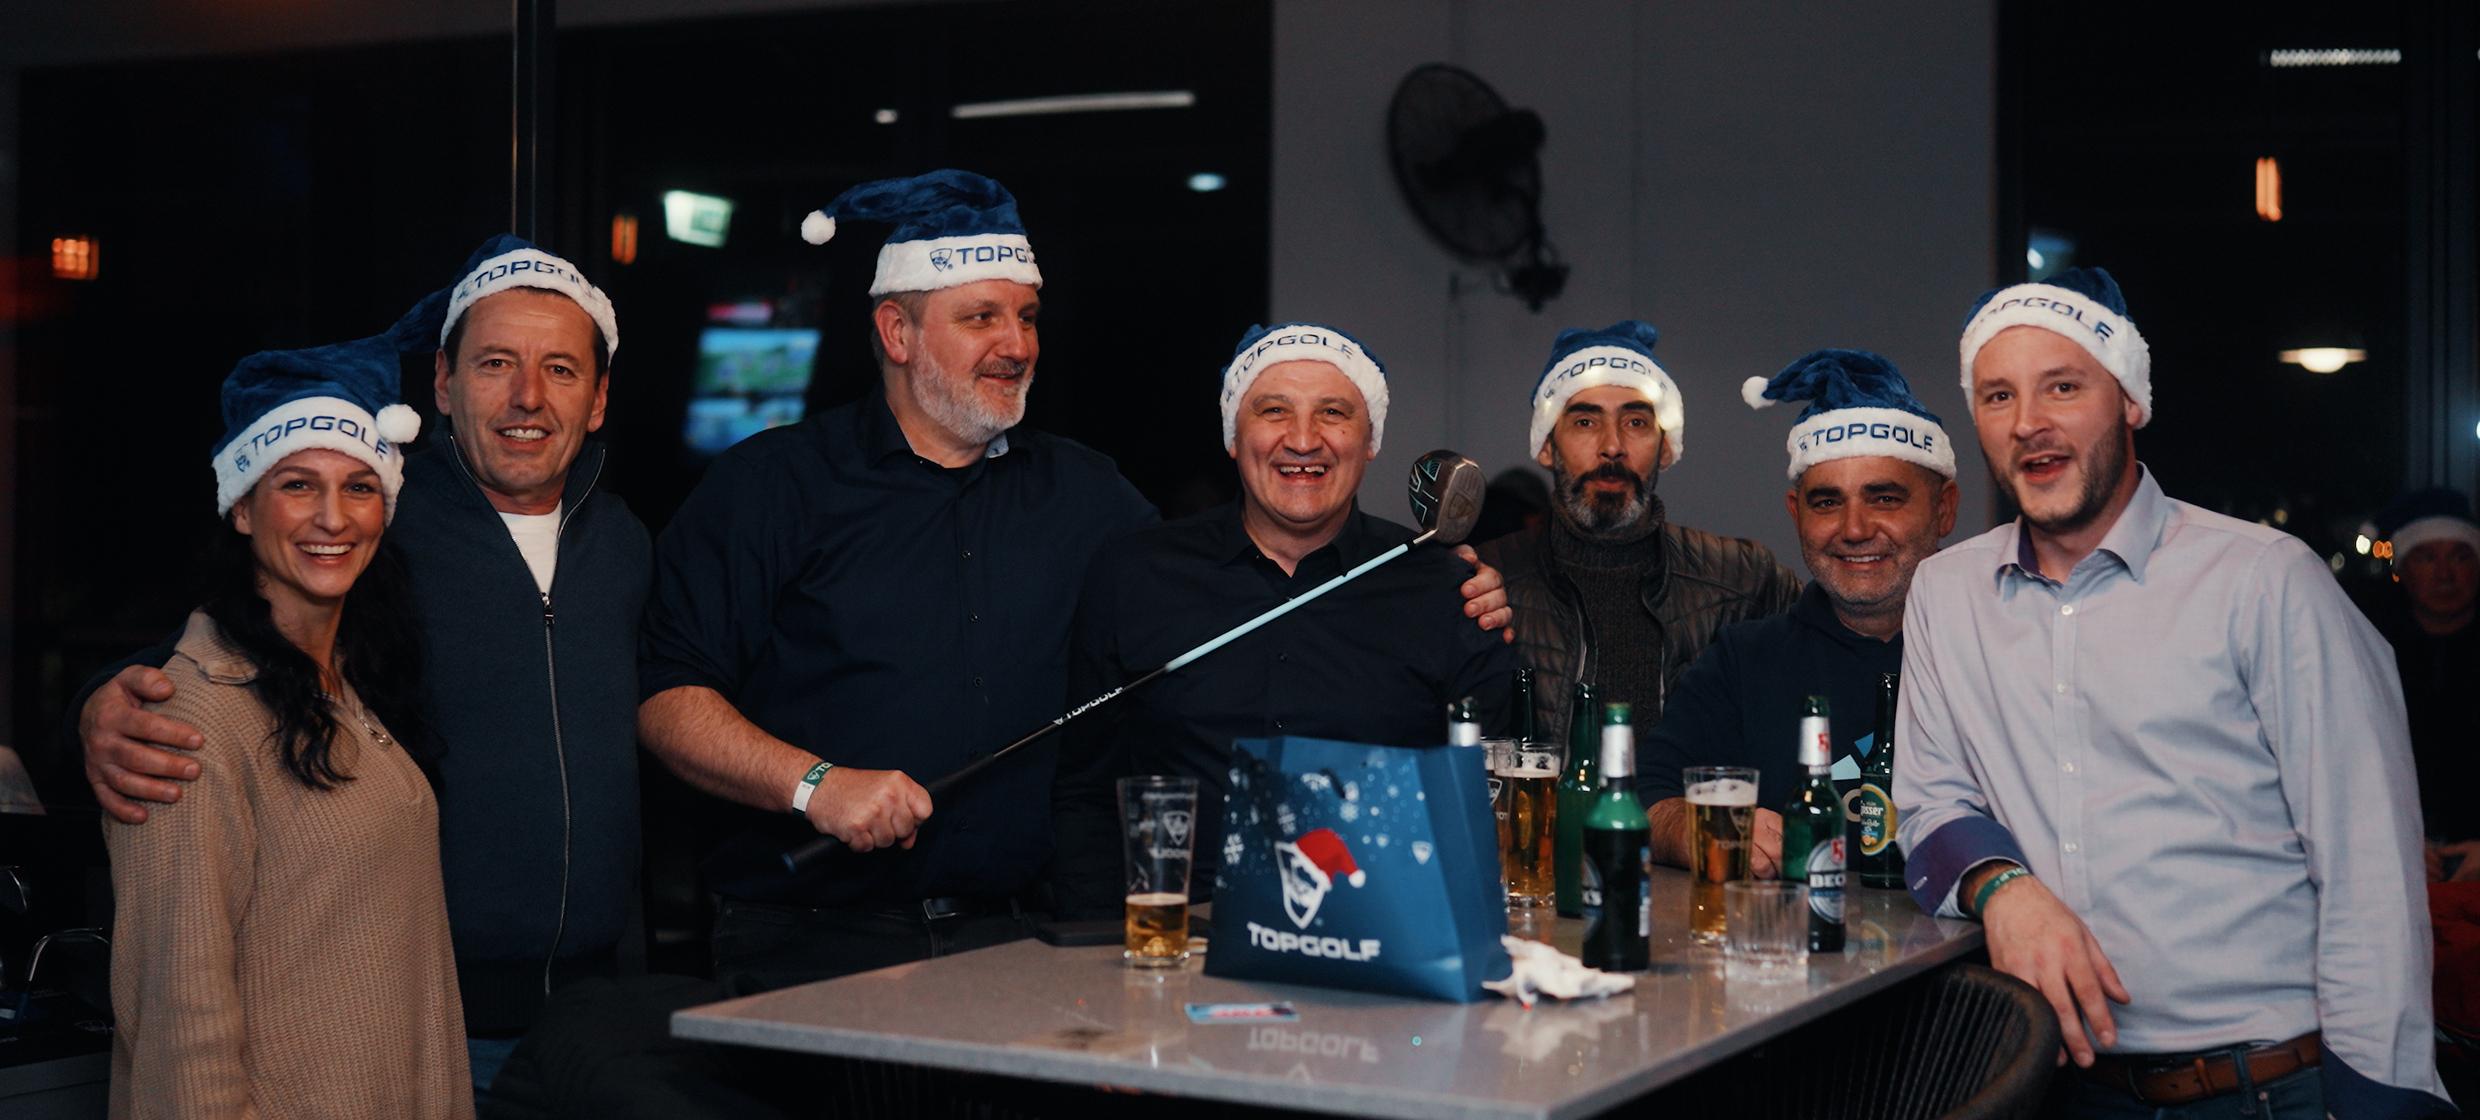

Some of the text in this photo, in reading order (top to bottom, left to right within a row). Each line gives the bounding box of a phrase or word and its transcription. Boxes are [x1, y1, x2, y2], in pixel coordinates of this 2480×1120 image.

[956, 245, 1036, 264] TOPG
[251, 416, 389, 462] TOPGOLF
[1813, 423, 1933, 453] TOPGOLF
[1247, 921, 1381, 962] TOPGOLF
